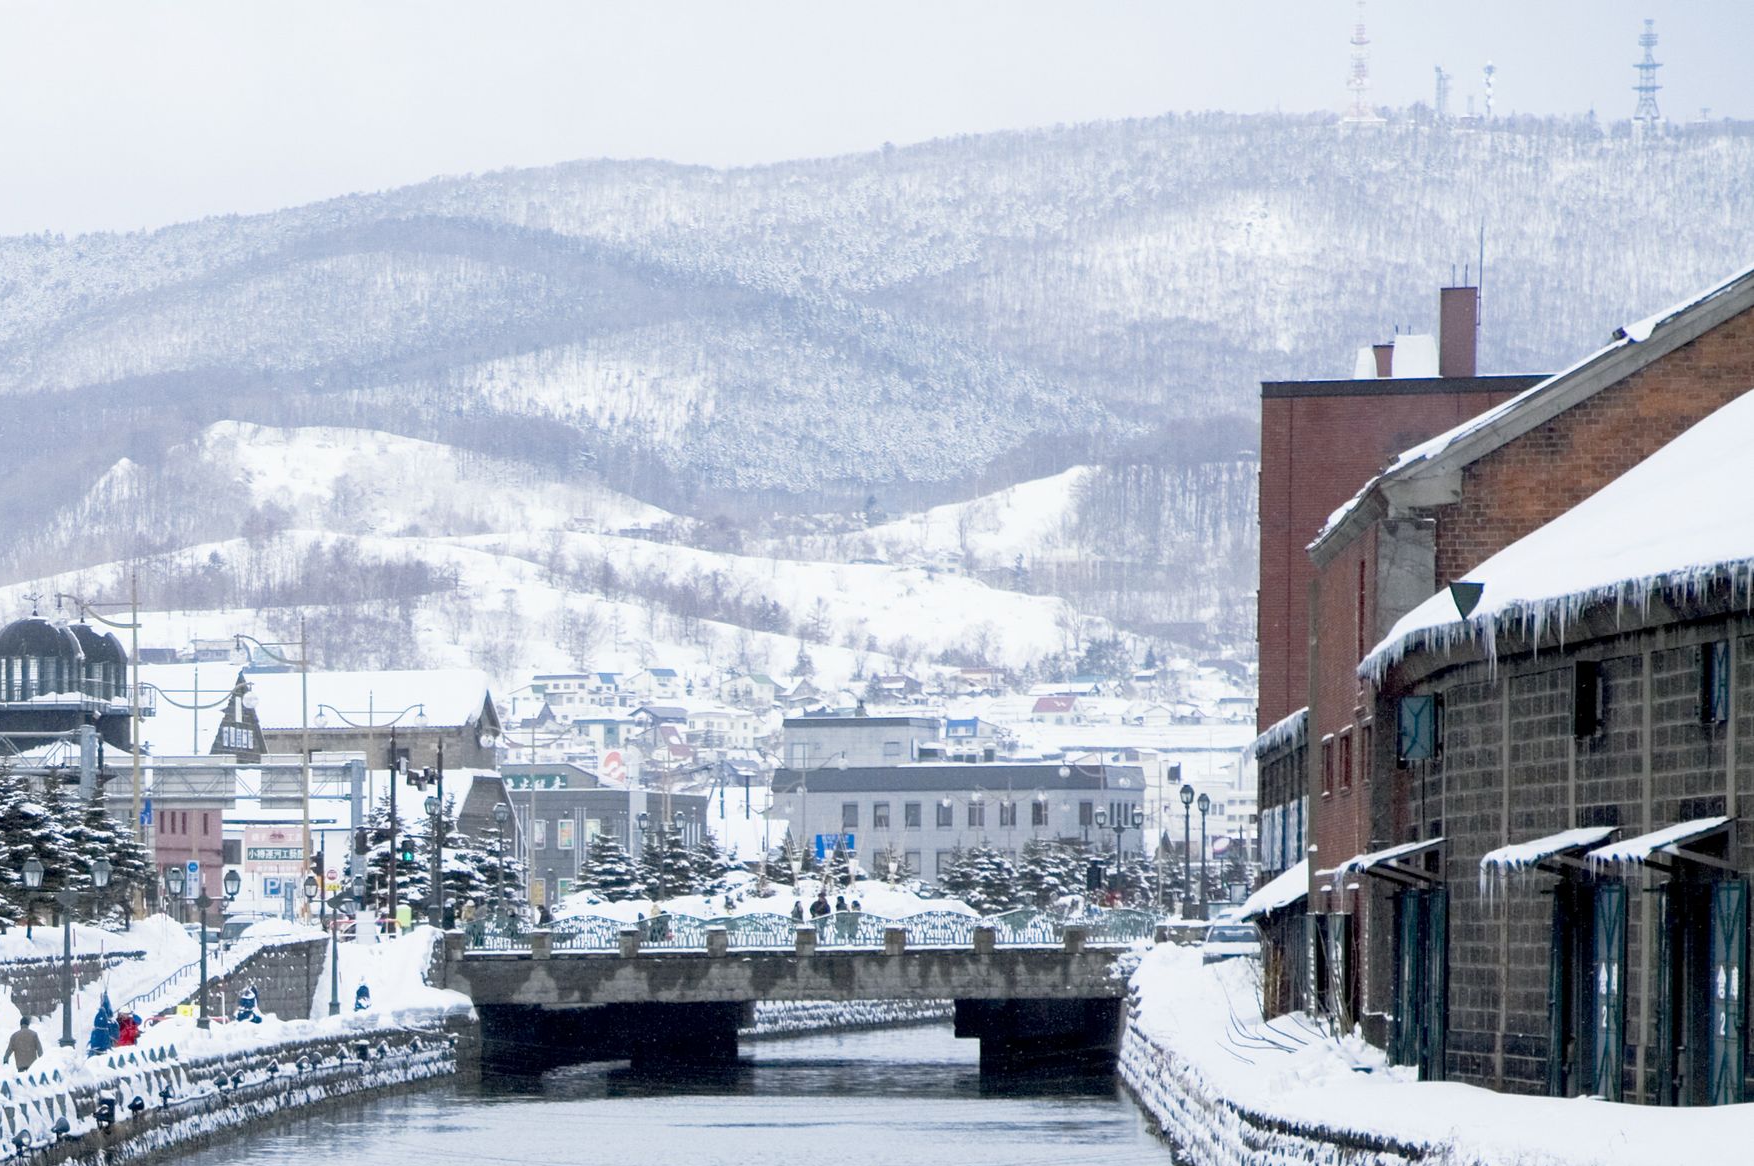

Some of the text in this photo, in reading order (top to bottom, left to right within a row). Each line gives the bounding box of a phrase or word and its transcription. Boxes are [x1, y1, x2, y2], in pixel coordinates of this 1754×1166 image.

[266, 879, 280, 895] P
[1602, 1005, 1607, 1028] 2
[1720, 1012, 1726, 1036] 2
